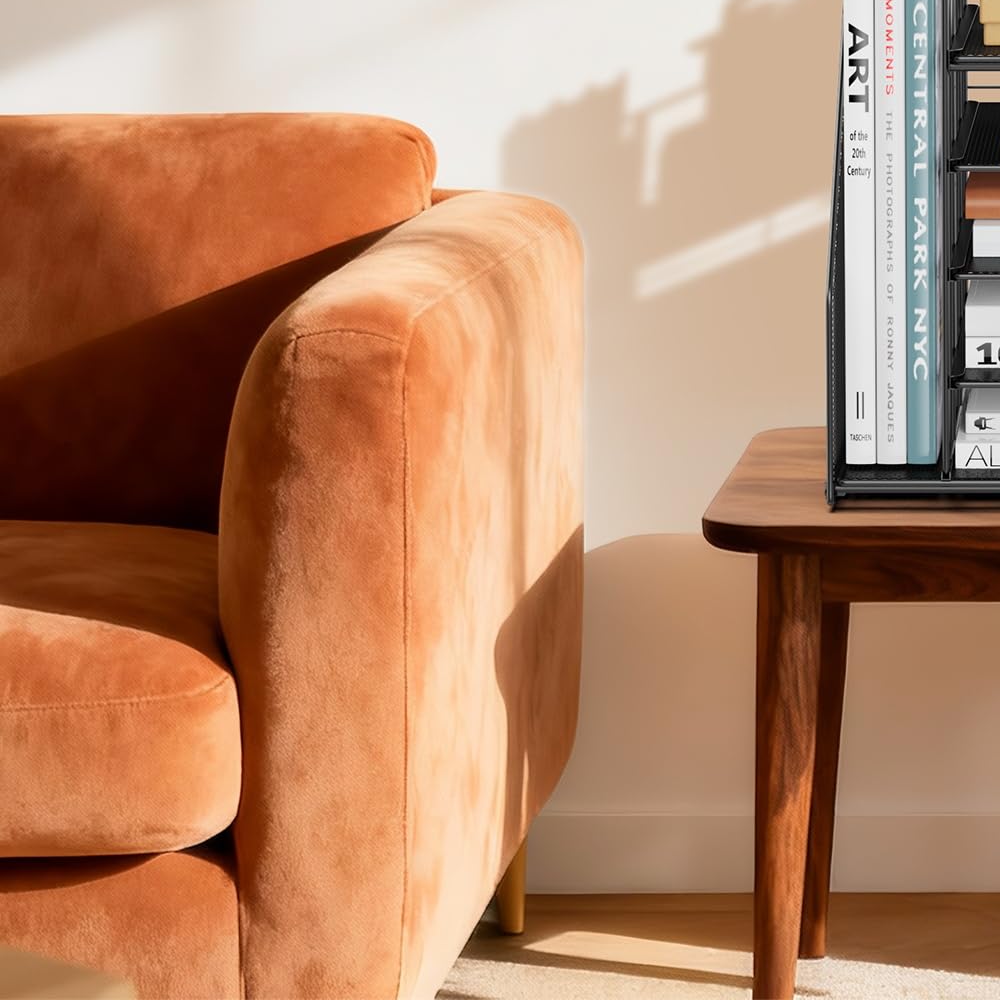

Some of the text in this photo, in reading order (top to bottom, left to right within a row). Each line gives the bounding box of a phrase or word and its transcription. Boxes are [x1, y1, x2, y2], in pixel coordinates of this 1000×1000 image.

[848, 23, 869, 113] ART
[849, 130, 868, 141] of the
[885, 112, 893, 141] THE
[851, 148, 866, 158] 20th
[846, 165, 872, 179] Century
[913, 1, 928, 381] CENTRAL PARK NYC
[886, 153, 894, 273] PHOTOGRAPHS
[886, 283, 894, 304] OF
[887, 383, 895, 443] JAQUES
[849, 433, 872, 442] TASCHEN
